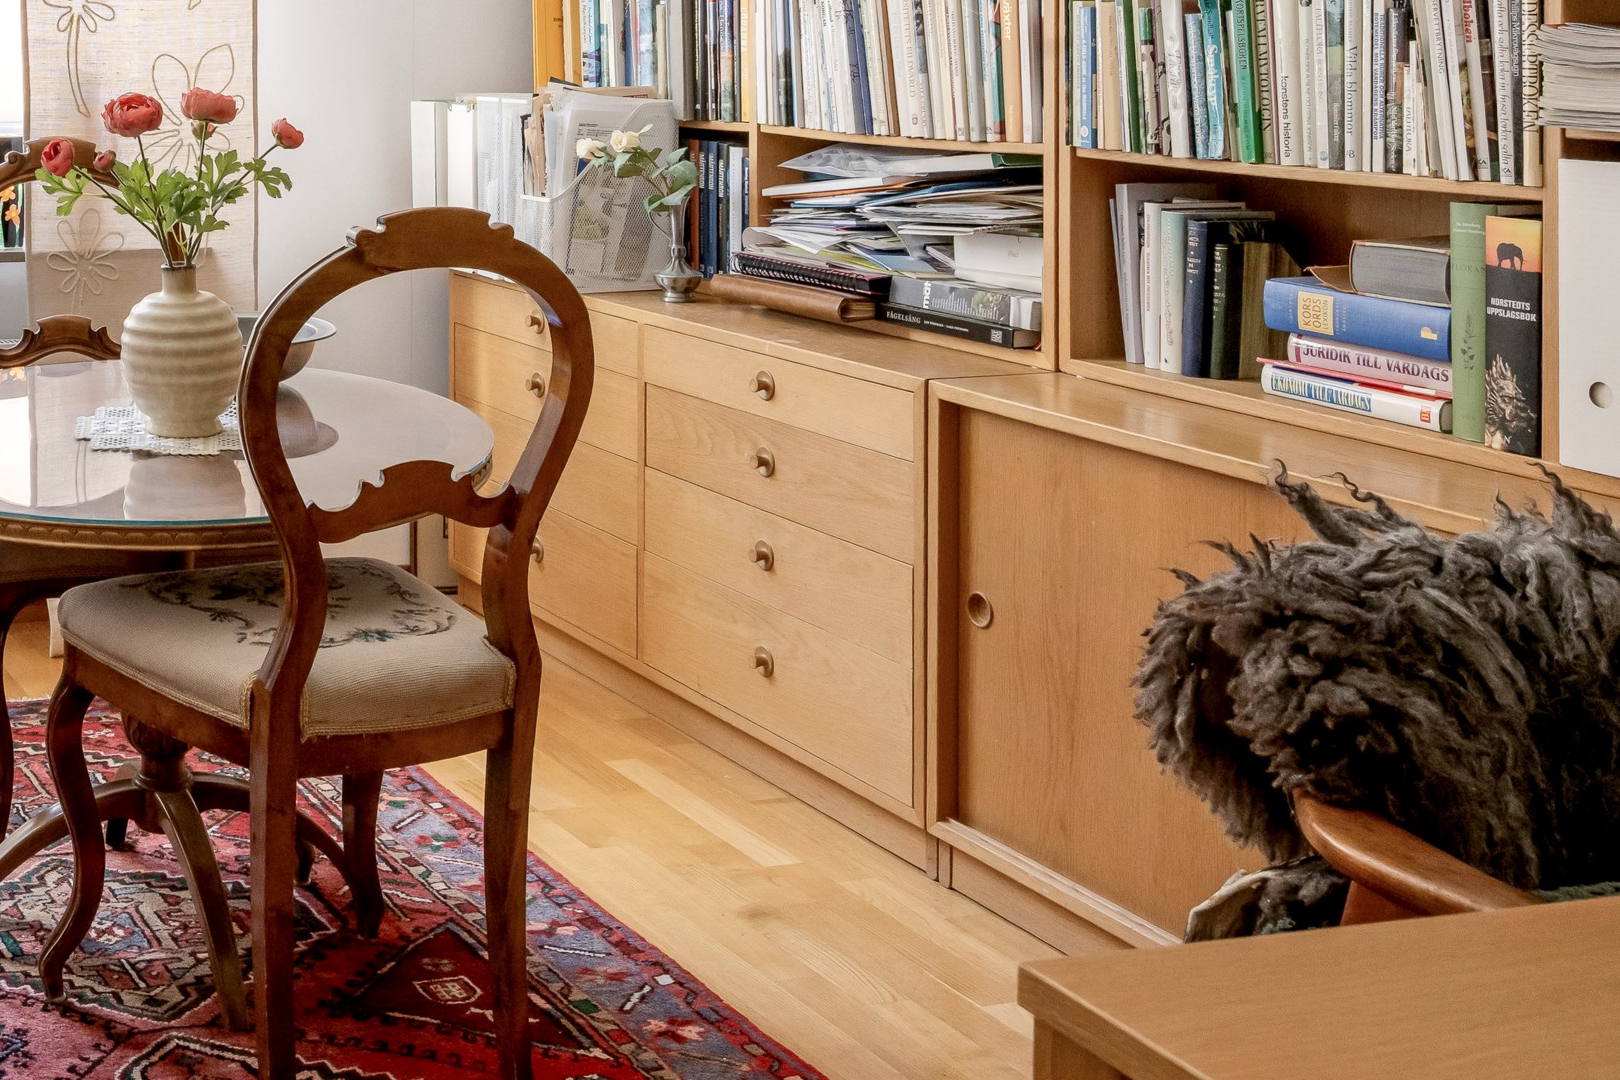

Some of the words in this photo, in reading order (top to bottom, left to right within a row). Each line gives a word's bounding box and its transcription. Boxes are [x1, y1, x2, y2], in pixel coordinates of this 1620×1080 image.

[1346, 45, 1358, 79] Vilda
[1511, 21, 1521, 77] Mikrovågsugn
[1280, 75, 1291, 120] konstens
[1346, 81, 1358, 136] blommor
[1282, 122, 1292, 158] historia
[718, 159, 726, 198] MÅRTENSON
[1301, 296, 1312, 327] KORS
[1312, 298, 1322, 329] ORDS
[1486, 306, 1537, 322] UPPSLAGSBOK
[1490, 297, 1531, 311] NORSTEDTS
[1301, 344, 1352, 364] JURIDIK
[1354, 352, 1382, 370] TILL
[1385, 358, 1450, 383] VARDAGS
[1271, 371, 1309, 398] EKONOMI
[1309, 382, 1331, 400] TILL
[1331, 388, 1372, 412] VARDAGS
